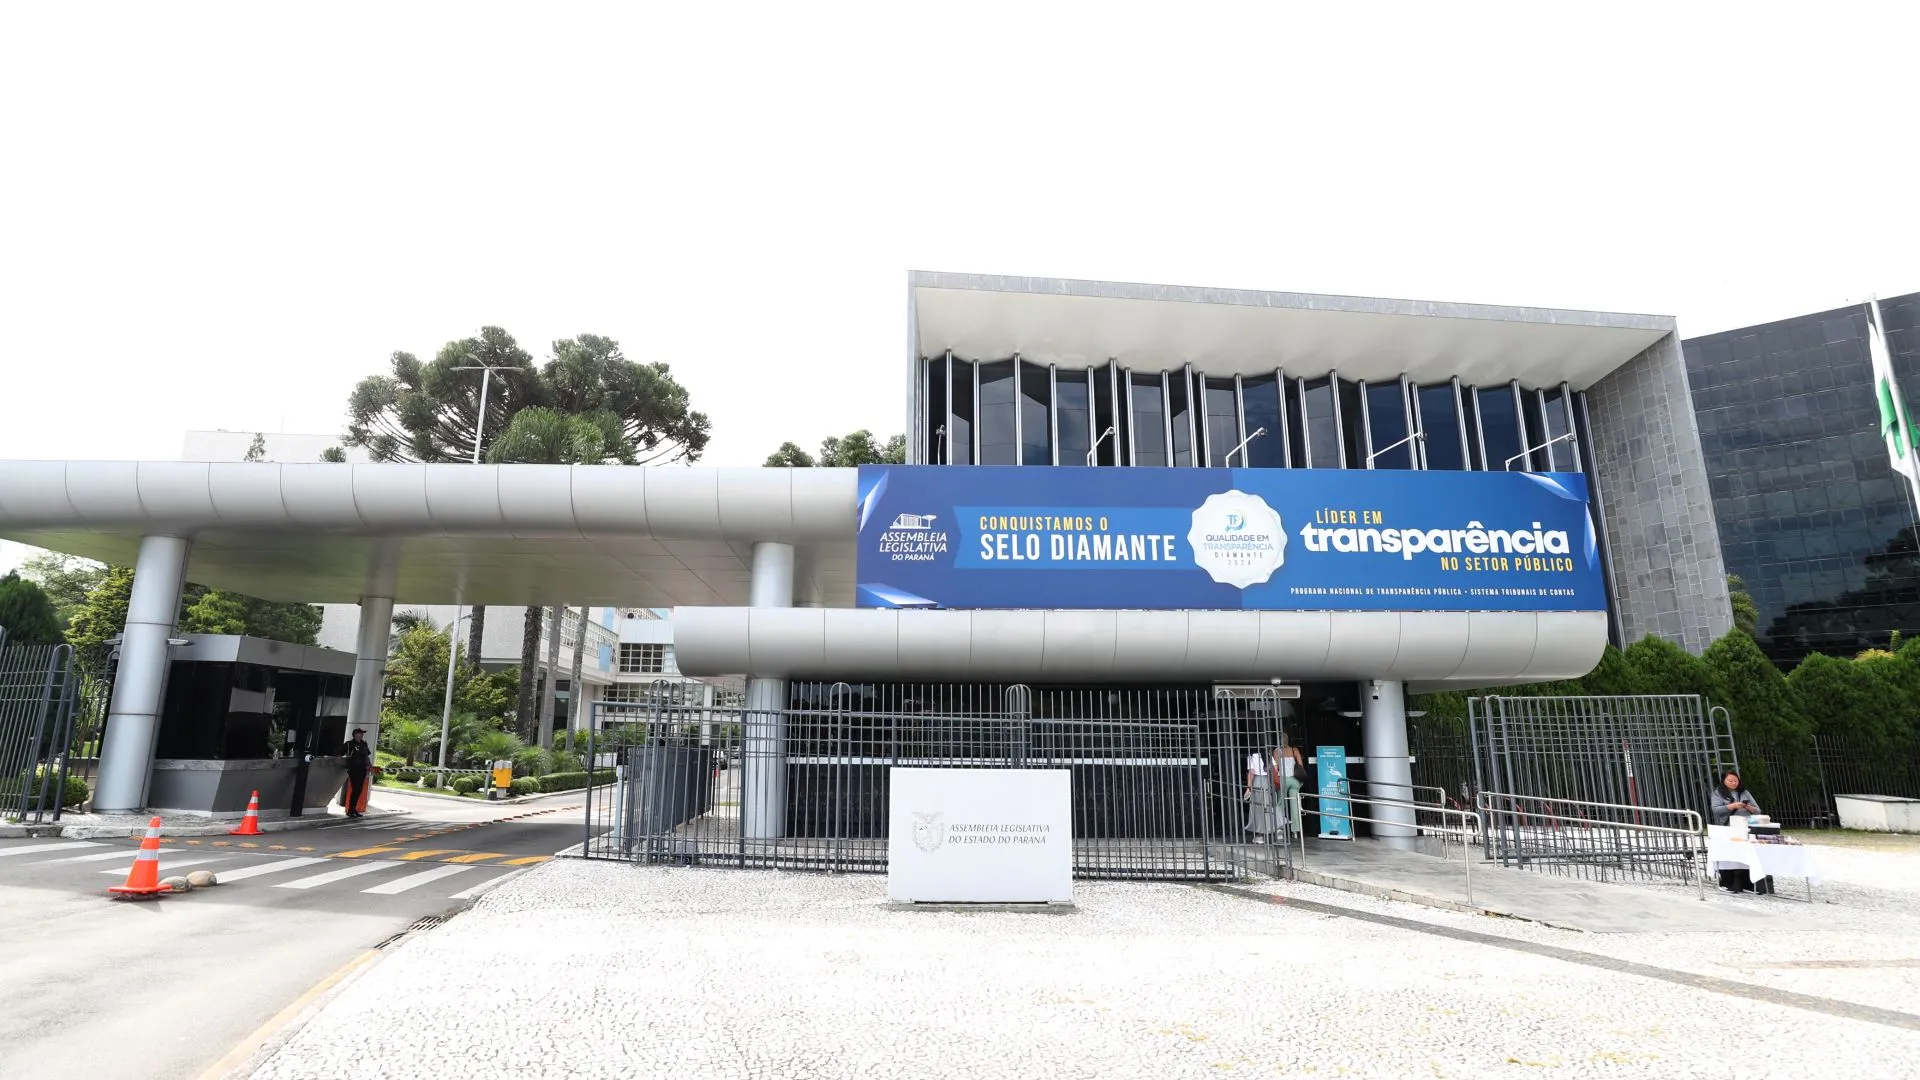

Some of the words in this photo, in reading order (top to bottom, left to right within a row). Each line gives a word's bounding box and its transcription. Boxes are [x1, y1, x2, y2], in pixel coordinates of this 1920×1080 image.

[1316, 508, 1356, 524] LÍDER
[1363, 511, 1383, 524] EM
[980, 516, 1093, 531] CONQUISTAMOS
[1100, 517, 1108, 531] O
[880, 532, 947, 542] ASSEMBLEIA
[1206, 534, 1255, 542] QUALIDADE
[1256, 534, 1270, 542] EM
[1300, 520, 1570, 560] transparência
[879, 543, 947, 553] LEGISLATIVA
[980, 533, 1040, 561] SELO
[1051, 534, 1177, 561] DIAMANTE
[1203, 541, 1274, 551] TRANSPARÊNCIA
[905, 553, 935, 561] PARANÁ
[1440, 556, 1459, 571] NO
[1465, 557, 1509, 571] SETOR
[1515, 555, 1573, 572] PÚBLICO
[1290, 587, 1327, 595] PROGRAMA
[1377, 586, 1431, 595] TRANSPARÊNCIA
[1434, 587, 1461, 596] PÚBLICA
[1470, 588, 1499, 596] SISTEMA
[1501, 588, 1537, 596] TRIBUNAIS
[1539, 588, 1548, 596] DE
[1550, 588, 1575, 596] CONTAS
[950, 824, 998, 833] ASSEMBLEIA
[1000, 824, 1050, 833] LEGISLATIVA
[949, 835, 962, 844] DO
[963, 835, 996, 844] ESTADO
[998, 835, 1011, 844] DO
[1013, 835, 1046, 844] PARANÁ
